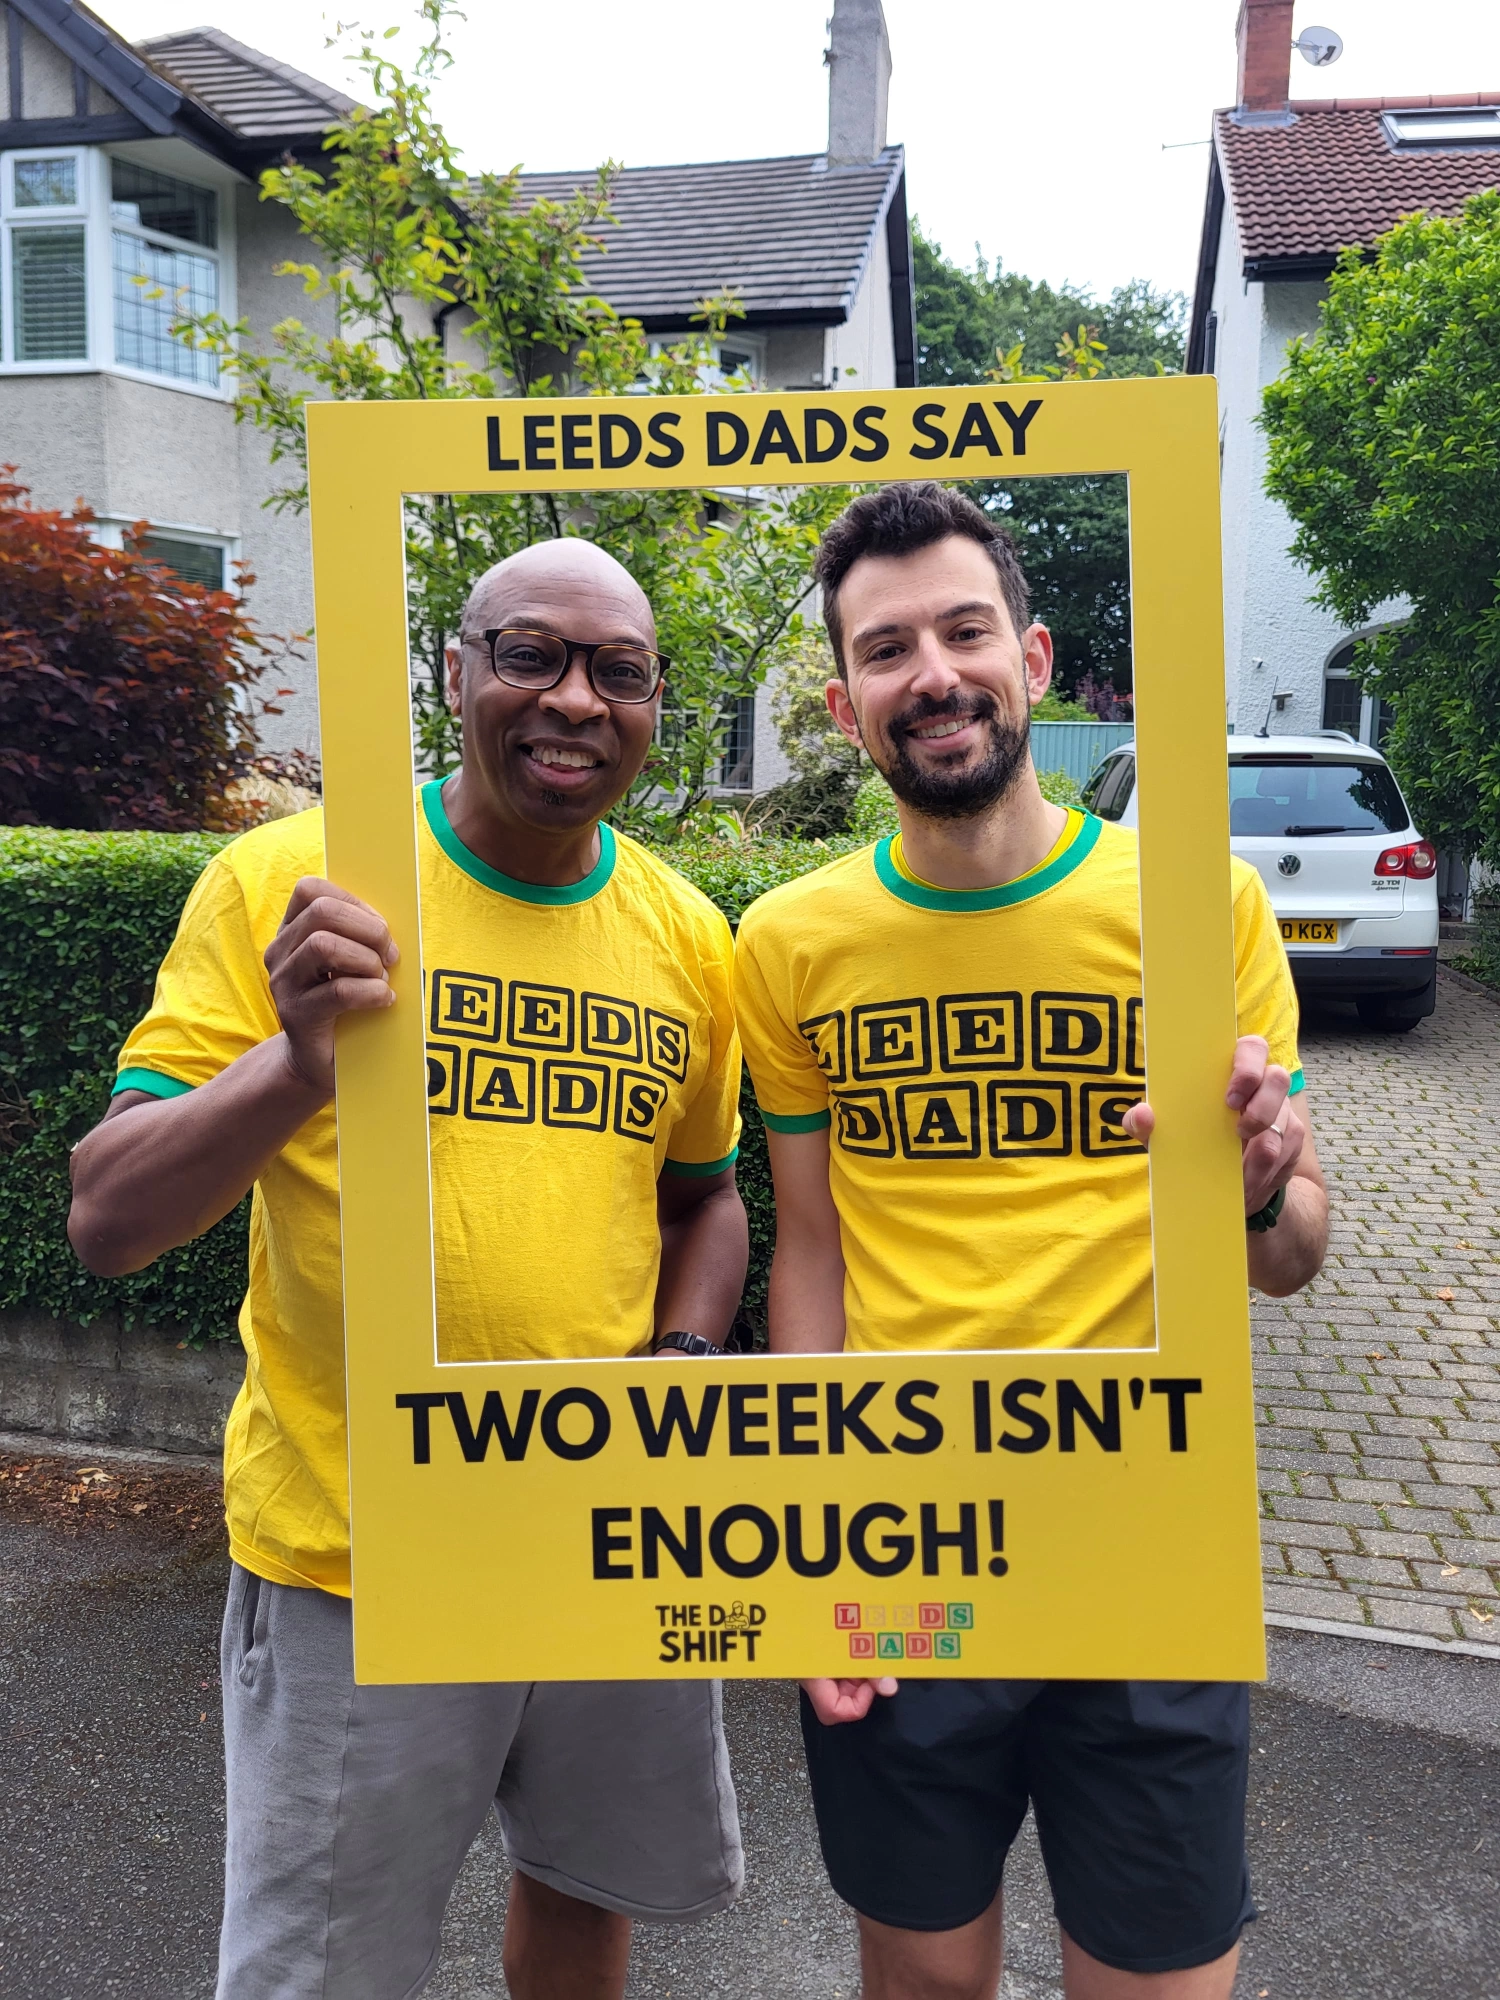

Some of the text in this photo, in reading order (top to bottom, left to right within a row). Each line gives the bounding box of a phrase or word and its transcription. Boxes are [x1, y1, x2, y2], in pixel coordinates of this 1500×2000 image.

[487, 399, 1044, 471] LEEDS DADS SAY
[1299, 922, 1334, 939] KGX
[438, 977, 686, 1073] EEDS
[803, 1002, 1110, 1073] LEED
[396, 1377, 1202, 1465] TWO WEEKS ISN'T
[591, 1499, 1009, 1581] ENOUGH!
[655, 1605, 702, 1626] THE
[837, 1605, 970, 1627] LEEDS
[659, 1630, 762, 1663] SHIFT
[851, 1635, 957, 1656] DADS
